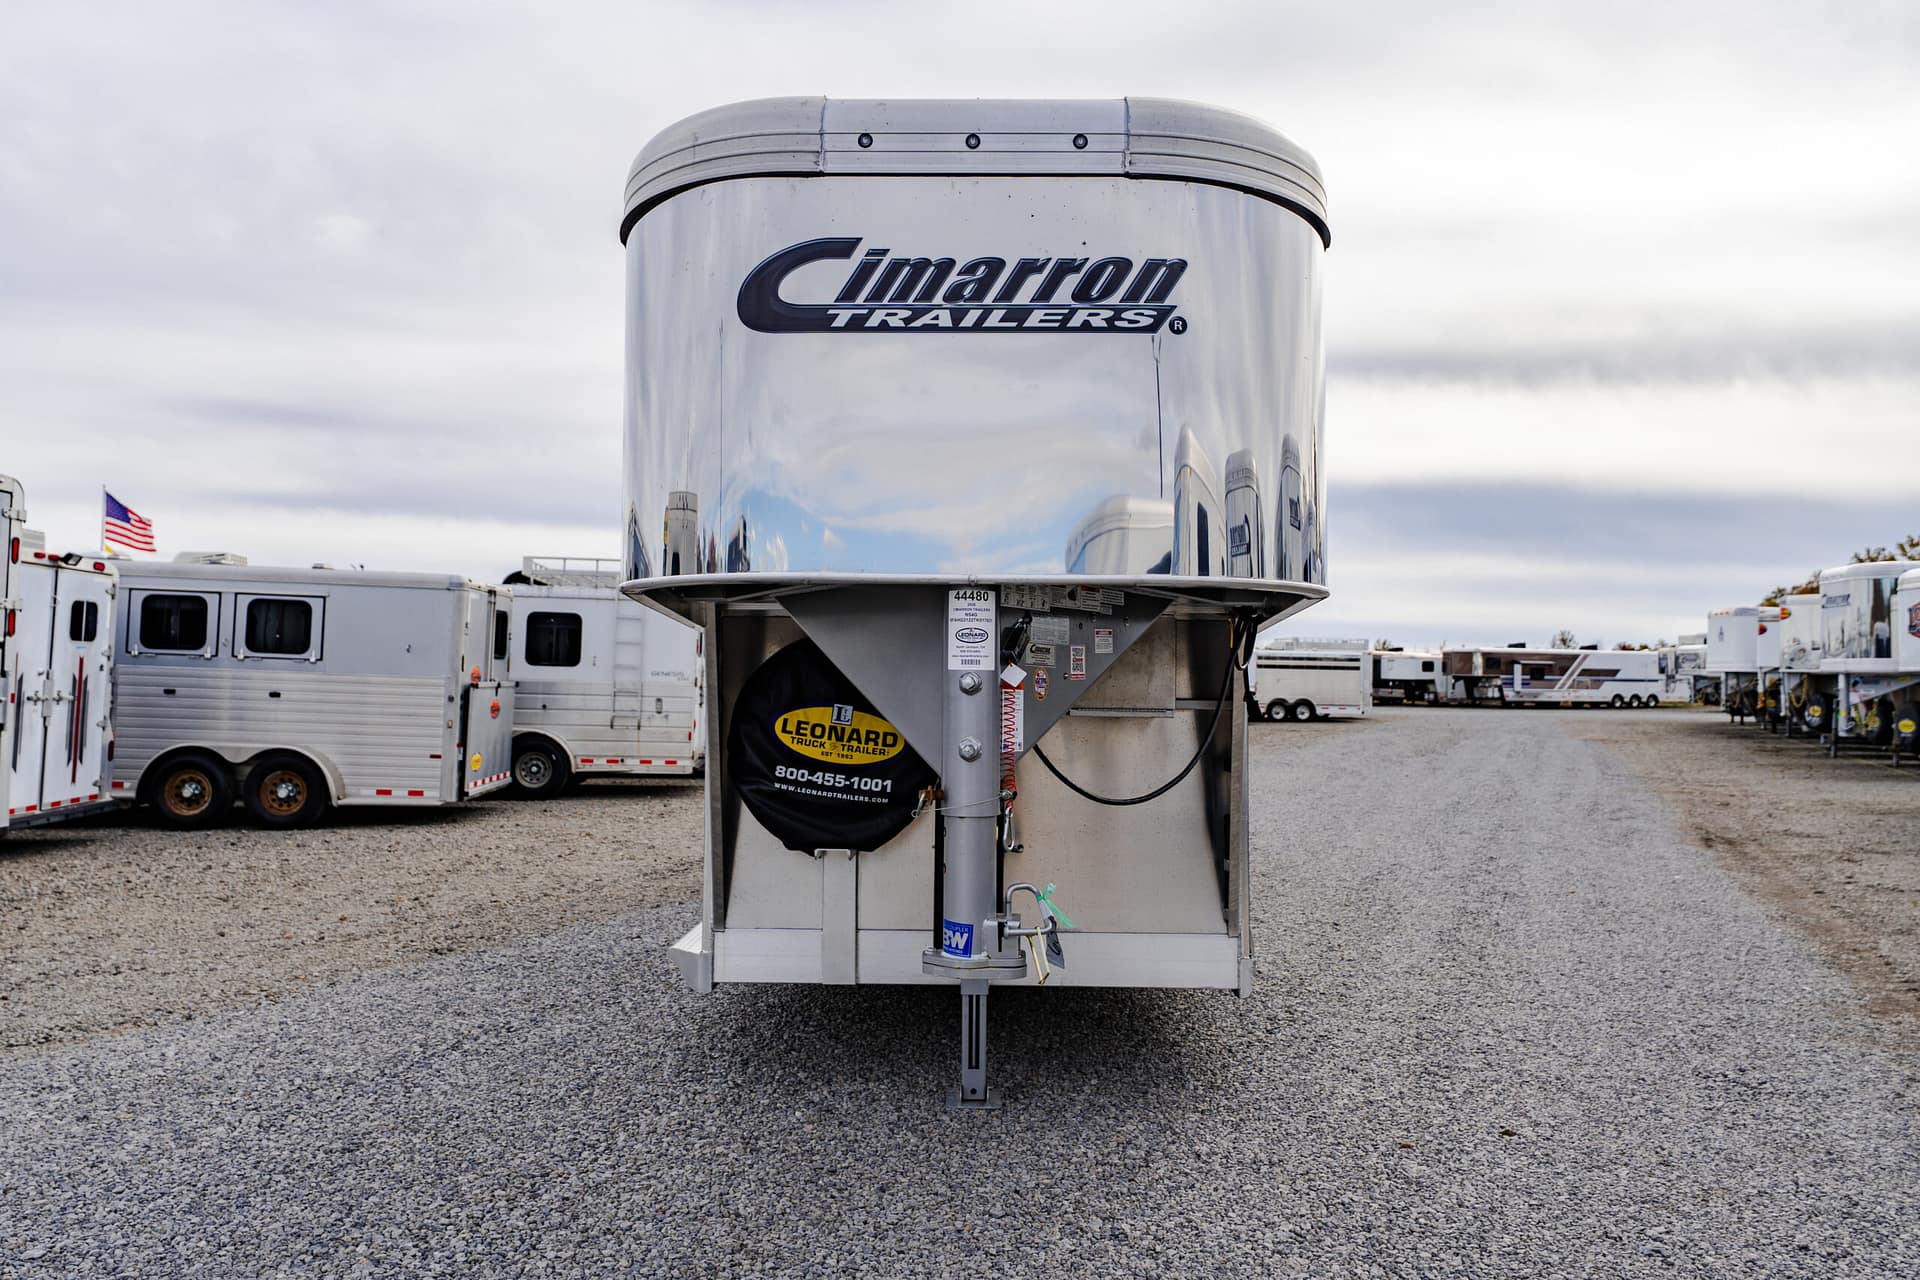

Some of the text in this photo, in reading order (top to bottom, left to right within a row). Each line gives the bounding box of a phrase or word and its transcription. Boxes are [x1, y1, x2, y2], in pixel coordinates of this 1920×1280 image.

[737, 237, 1188, 333] Cimarron
[826, 308, 1158, 329] TRAILERS
[954, 591, 989, 602] 44480
[781, 717, 898, 748] LEONARD
[790, 736, 826, 750] TRUCK
[841, 744, 886, 756] TRAILER
[775, 765, 893, 793] 800-455-1001
[774, 782, 889, 804] WWW.LEONARDTRAILERS.COM
